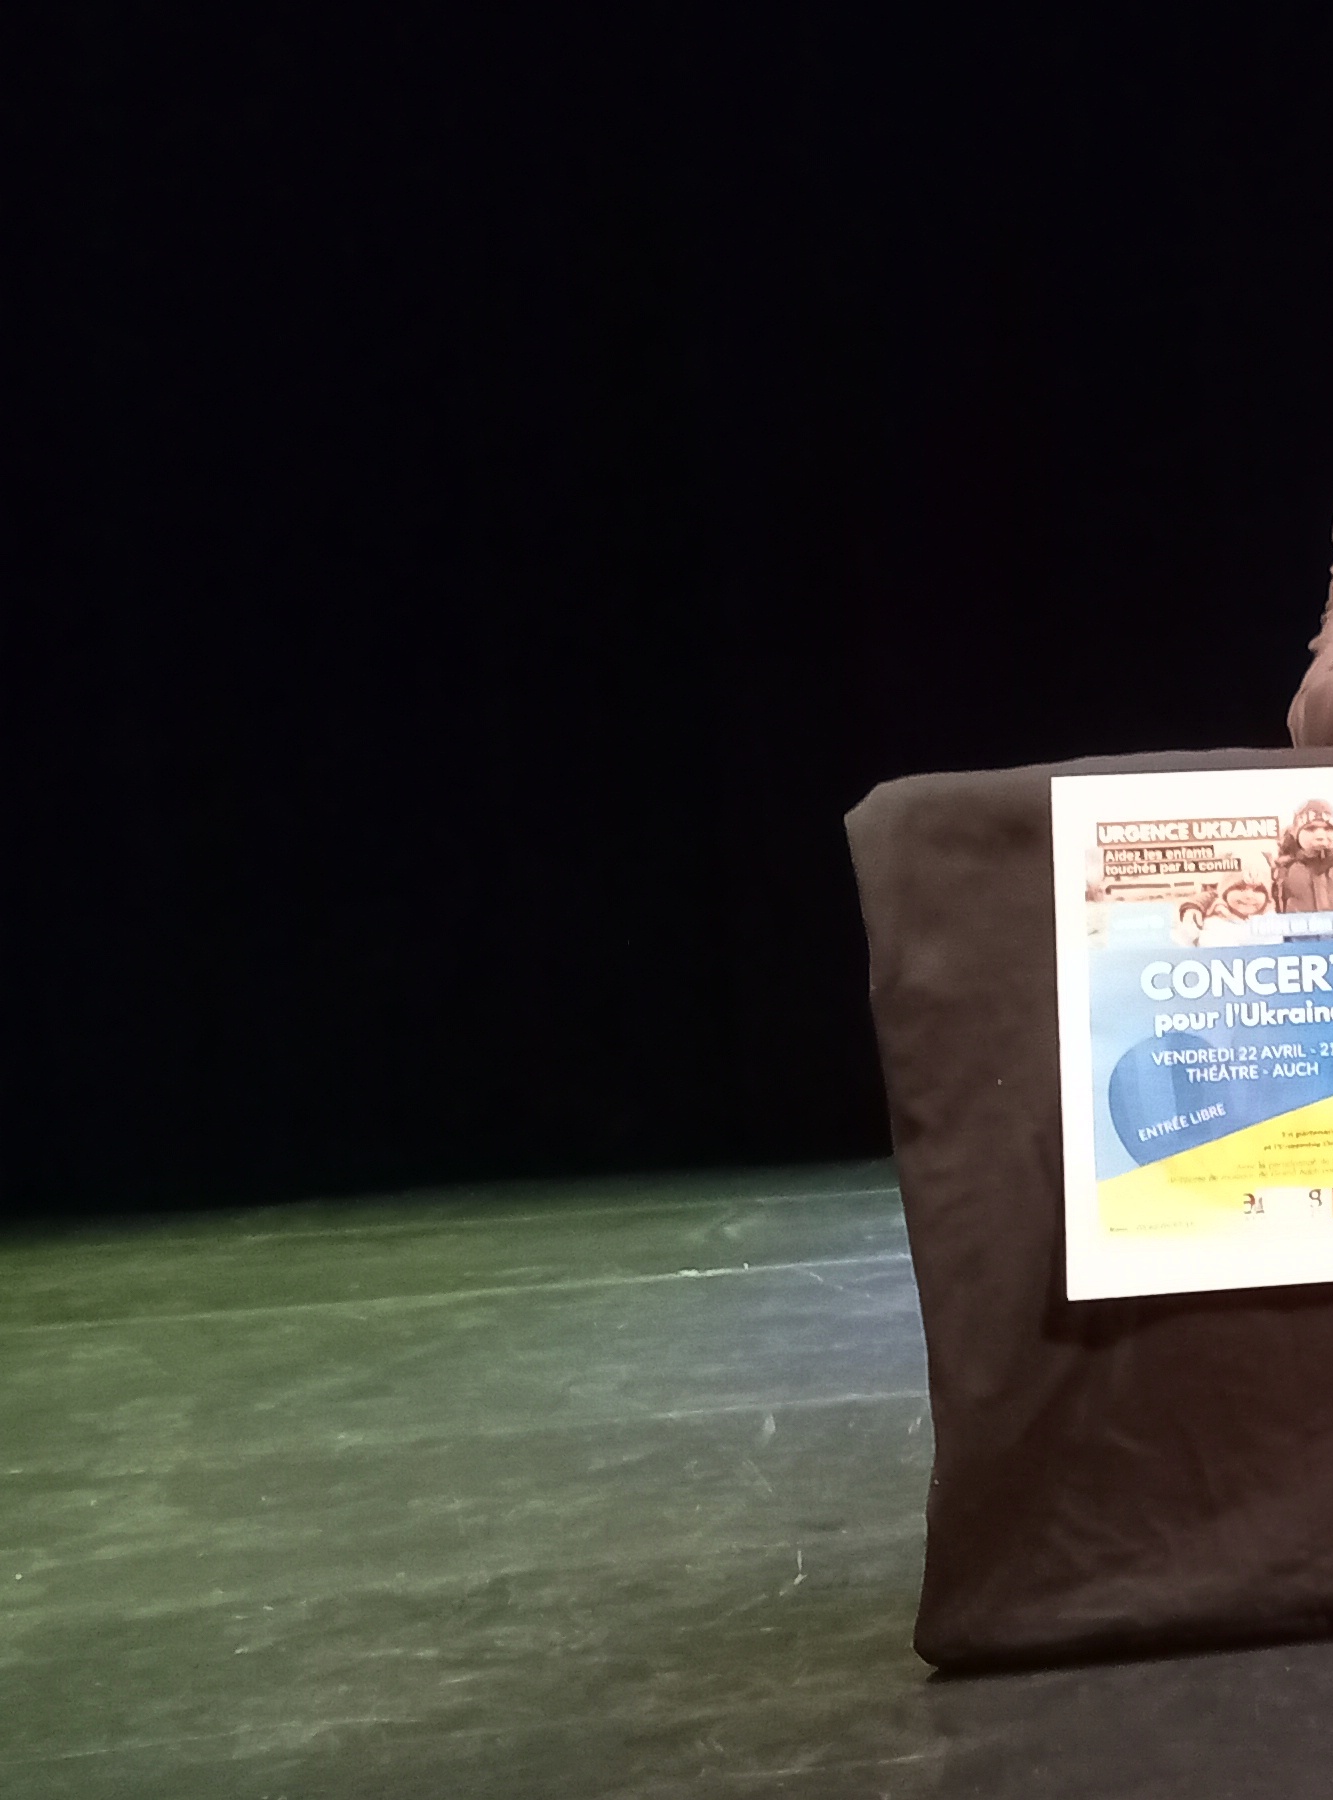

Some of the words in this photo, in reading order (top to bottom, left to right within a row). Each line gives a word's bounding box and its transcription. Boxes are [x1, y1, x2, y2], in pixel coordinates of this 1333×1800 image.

[1099, 823, 1190, 843] URGENCE
[1192, 819, 1277, 840] UKRAINE
[1160, 862, 1181, 875] par
[1183, 860, 1195, 871] le
[1154, 1010, 1219, 1037] pour
[1151, 1046, 1235, 1066] VENDREDI
[1238, 1046, 1258, 1062] 22
[1260, 1043, 1307, 1060] AVRIL
[1272, 1061, 1319, 1078] AUCH
[1137, 1114, 1190, 1142] ENTRÉE
[1189, 1101, 1227, 1125] LIBRE
